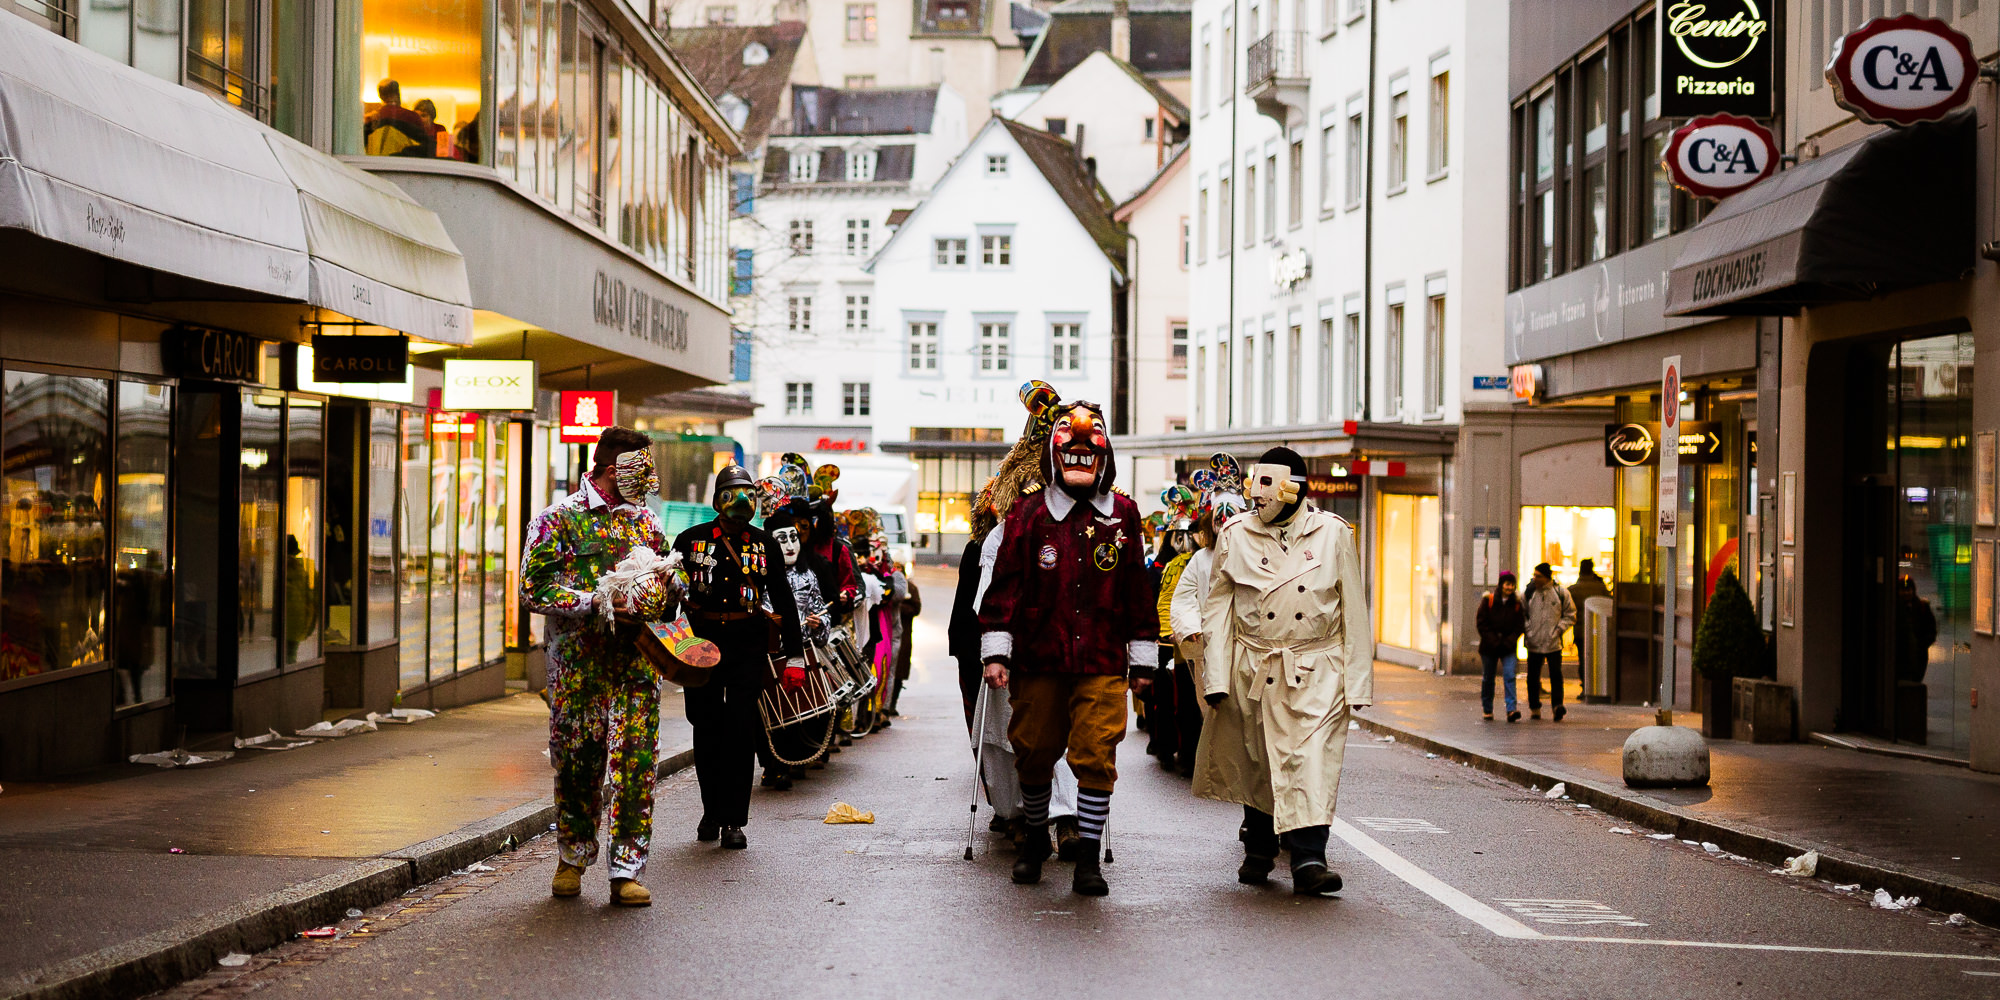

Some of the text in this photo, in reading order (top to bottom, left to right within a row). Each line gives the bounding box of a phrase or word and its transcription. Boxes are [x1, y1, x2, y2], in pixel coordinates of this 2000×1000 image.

[1667, 0, 1766, 37] Centro
[1863, 45, 1953, 91] C&A
[1677, 75, 1755, 95] Pizzeria
[1688, 138, 1760, 173] C&A
[1693, 252, 1762, 302] CLOCKHOUSE
[593, 271, 626, 332] GRAND
[320, 357, 397, 371] CAROLL
[455, 376, 520, 387] GEOX
[1609, 433, 1654, 451] Centro
[1678, 433, 1706, 444] rante
[1678, 445, 1698, 455] eria
[1308, 480, 1358, 494] Vögele
